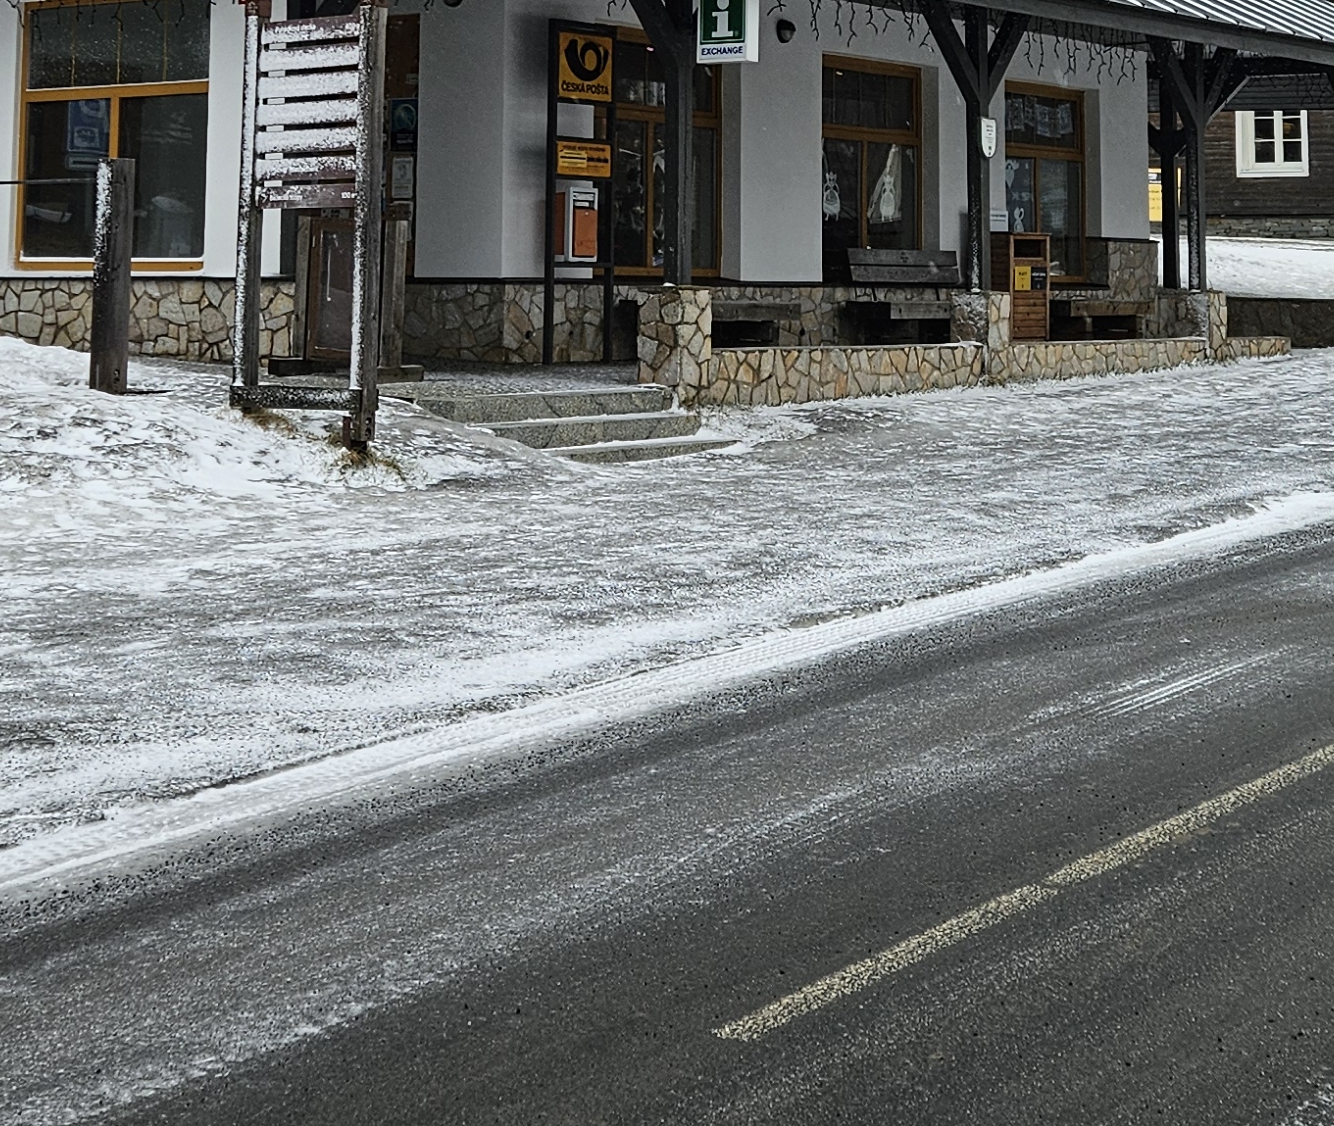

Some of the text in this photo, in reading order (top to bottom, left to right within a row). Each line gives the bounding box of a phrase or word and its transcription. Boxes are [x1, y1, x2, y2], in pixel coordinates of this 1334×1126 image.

[701, 46, 744, 56] EXCHANGE
[561, 80, 609, 95] ČESKÁ POŠTA
